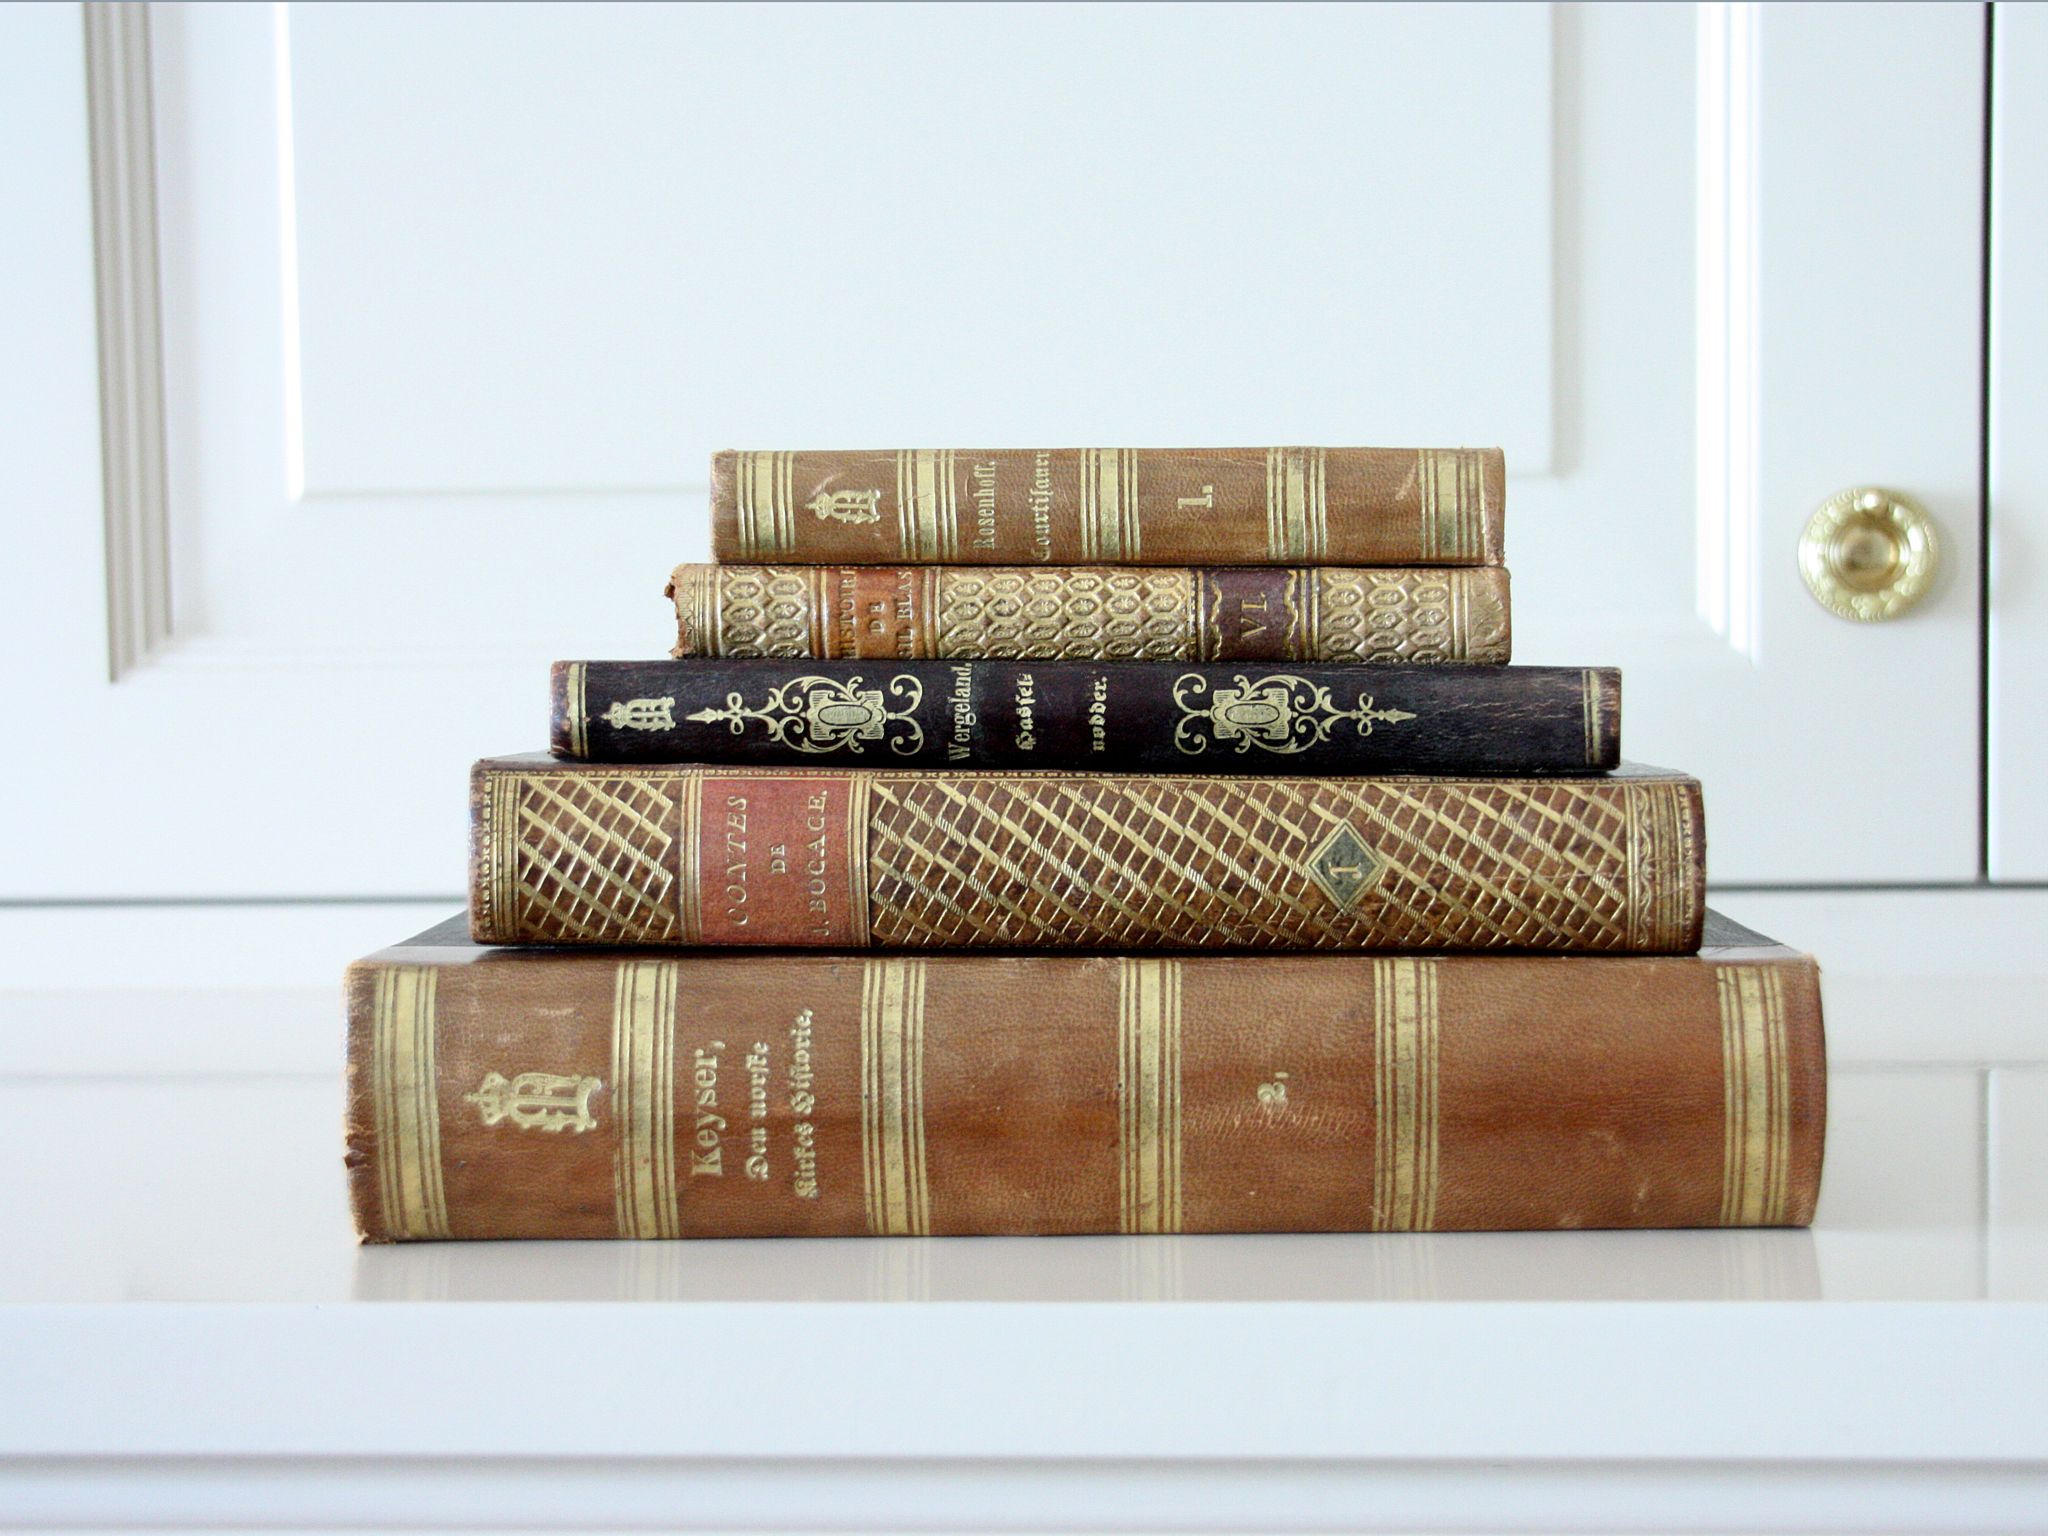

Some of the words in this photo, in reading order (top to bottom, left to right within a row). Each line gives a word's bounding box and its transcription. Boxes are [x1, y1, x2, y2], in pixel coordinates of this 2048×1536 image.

[973, 461, 995, 550] Rosenhoff.
[1178, 484, 1213, 509] 1.
[868, 601, 885, 634] DE
[948, 662, 977, 761] Wergeland.
[727, 795, 748, 926] CONTES
[770, 844, 786, 874] DE
[691, 1040, 726, 1176] Keyser,
[745, 1127, 769, 1180] Den
